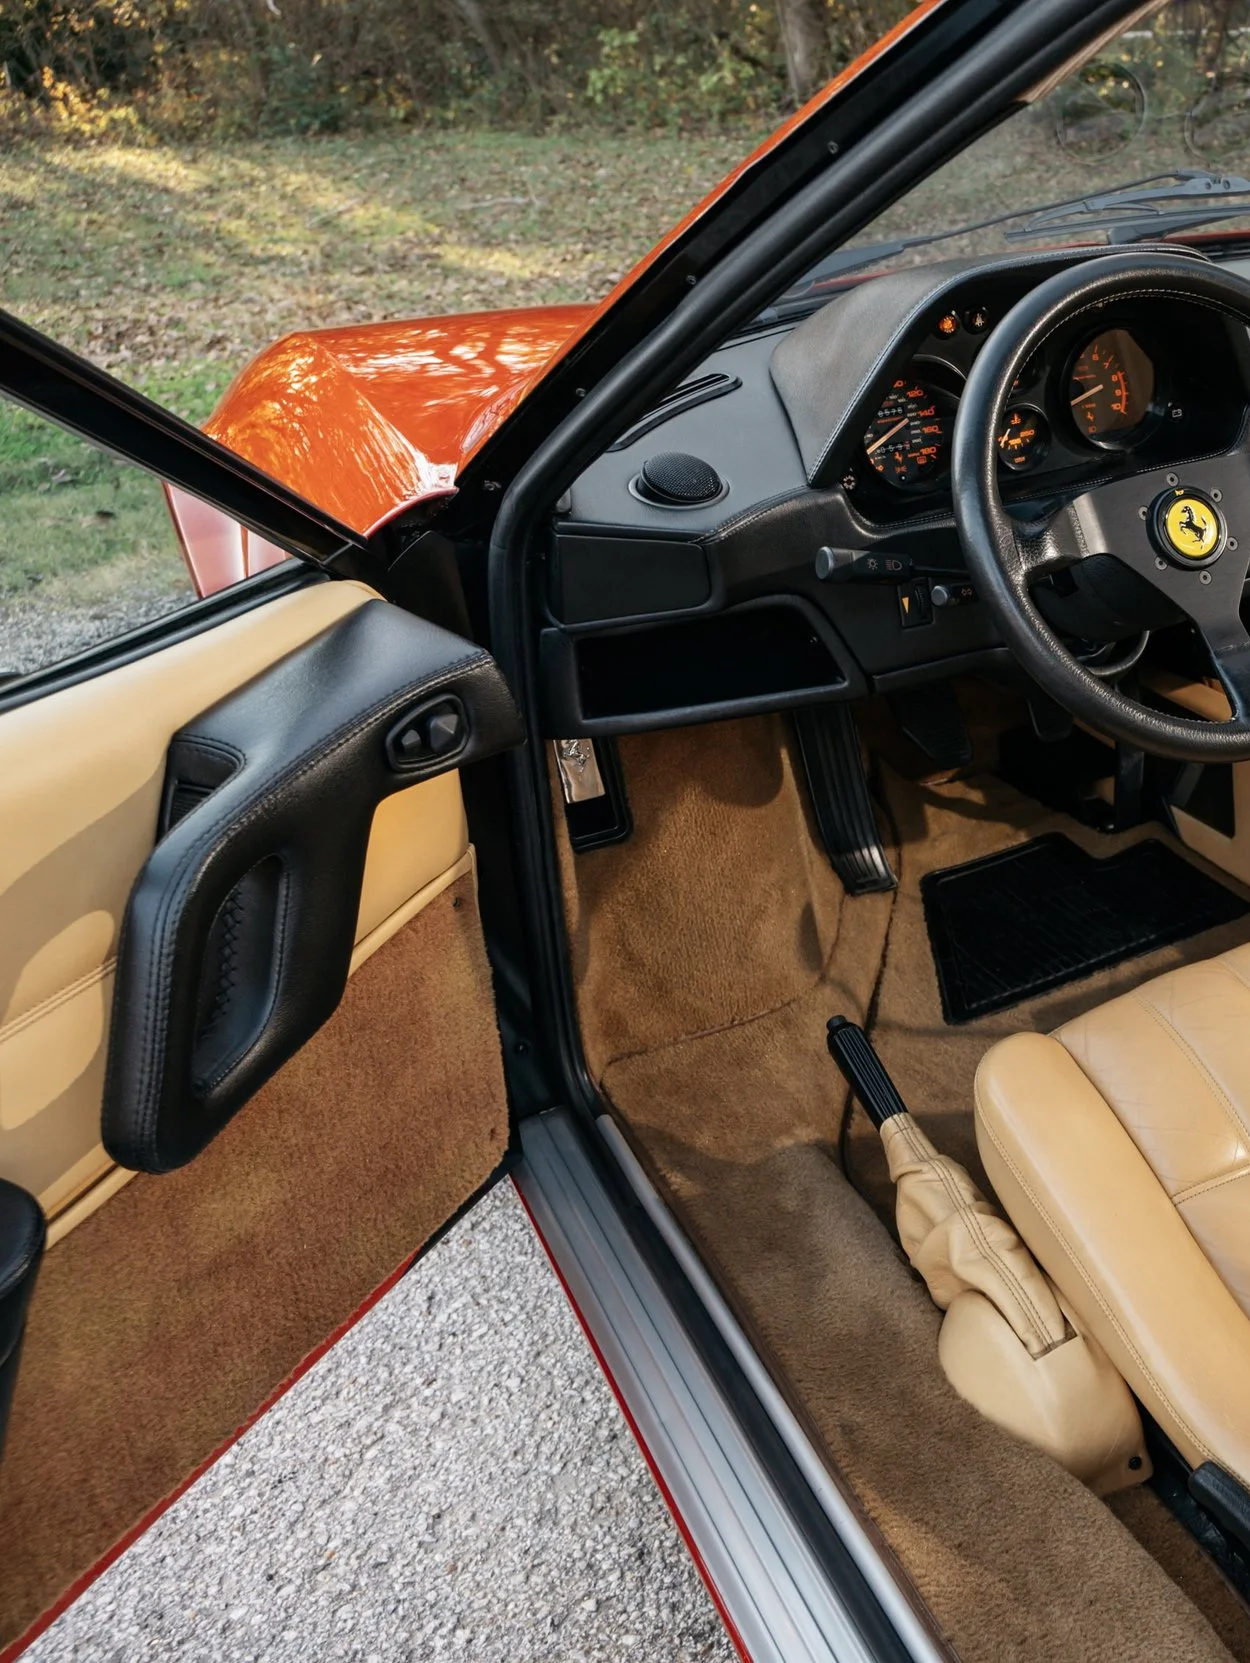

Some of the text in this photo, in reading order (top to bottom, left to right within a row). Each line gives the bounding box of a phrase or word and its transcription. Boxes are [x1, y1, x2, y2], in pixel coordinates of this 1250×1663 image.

[1111, 374, 1118, 382] 8
[1115, 389, 1122, 397] 9
[1111, 401, 1121, 410] 10
[918, 409, 935, 417] 140
[920, 446, 936, 454] 180
